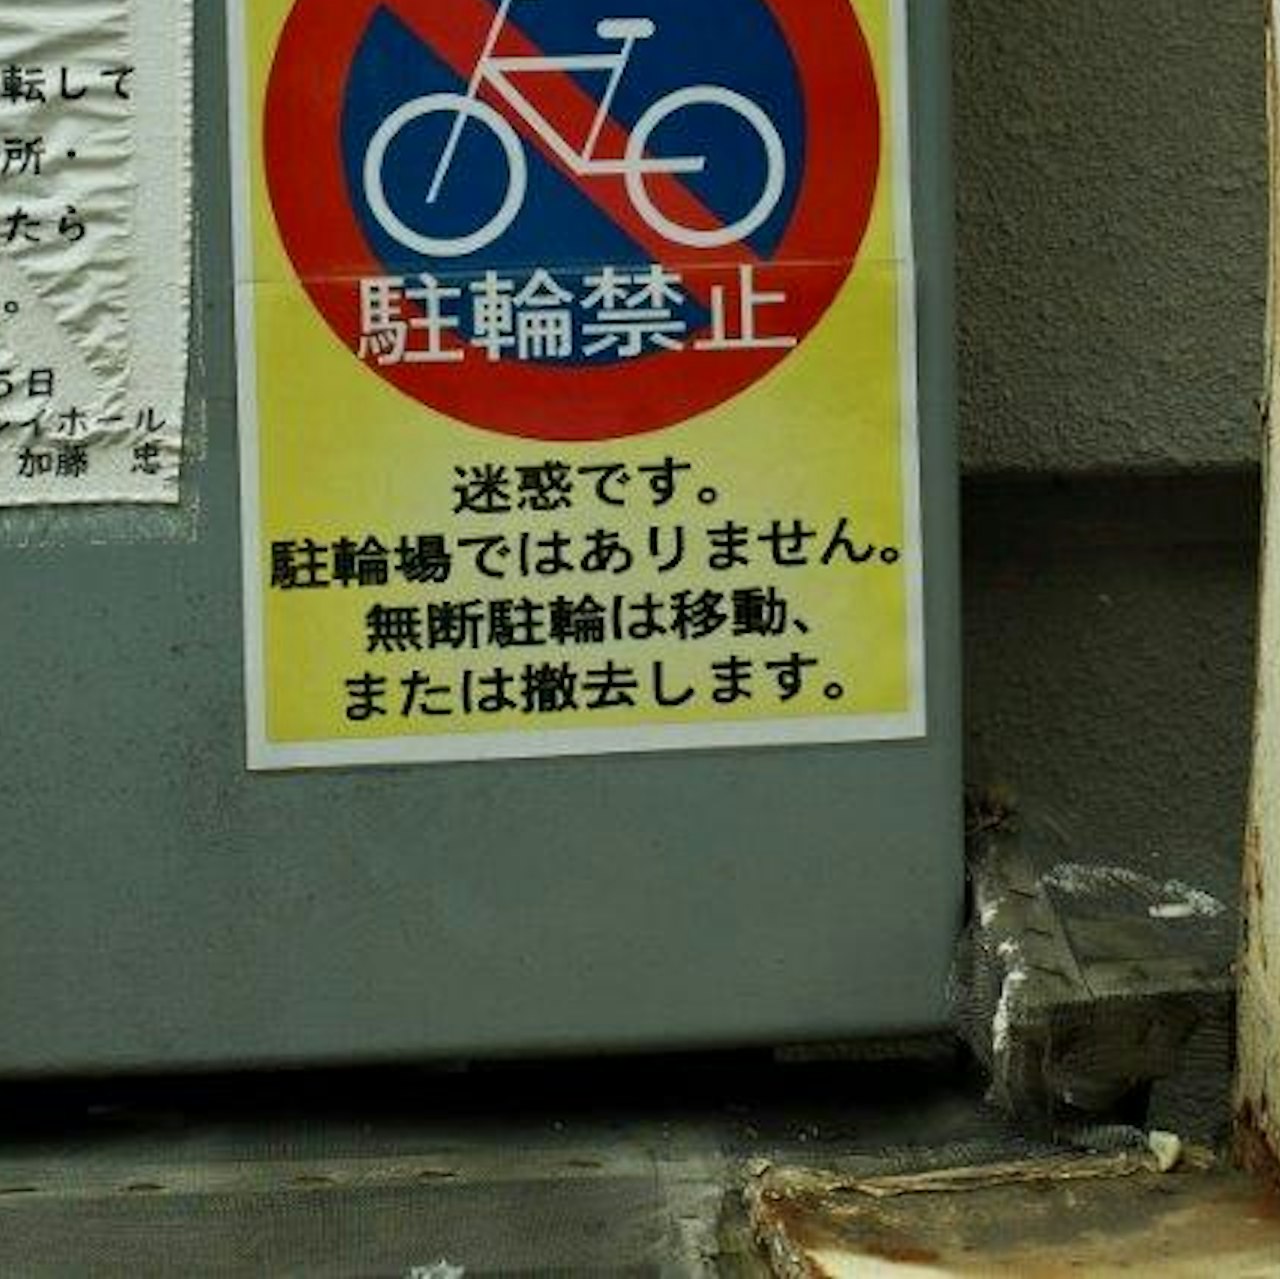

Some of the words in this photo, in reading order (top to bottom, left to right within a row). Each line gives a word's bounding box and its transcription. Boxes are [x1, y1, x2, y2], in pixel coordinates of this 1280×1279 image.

[357, 261, 798, 367] 駐輪禁止
[451, 454, 723, 517] 迷惑です。
[270, 516, 901, 591] 駐輪場ではありません。
[364, 591, 813, 653] 無断駐輪は移動、
[343, 650, 845, 721] または撤去します。
